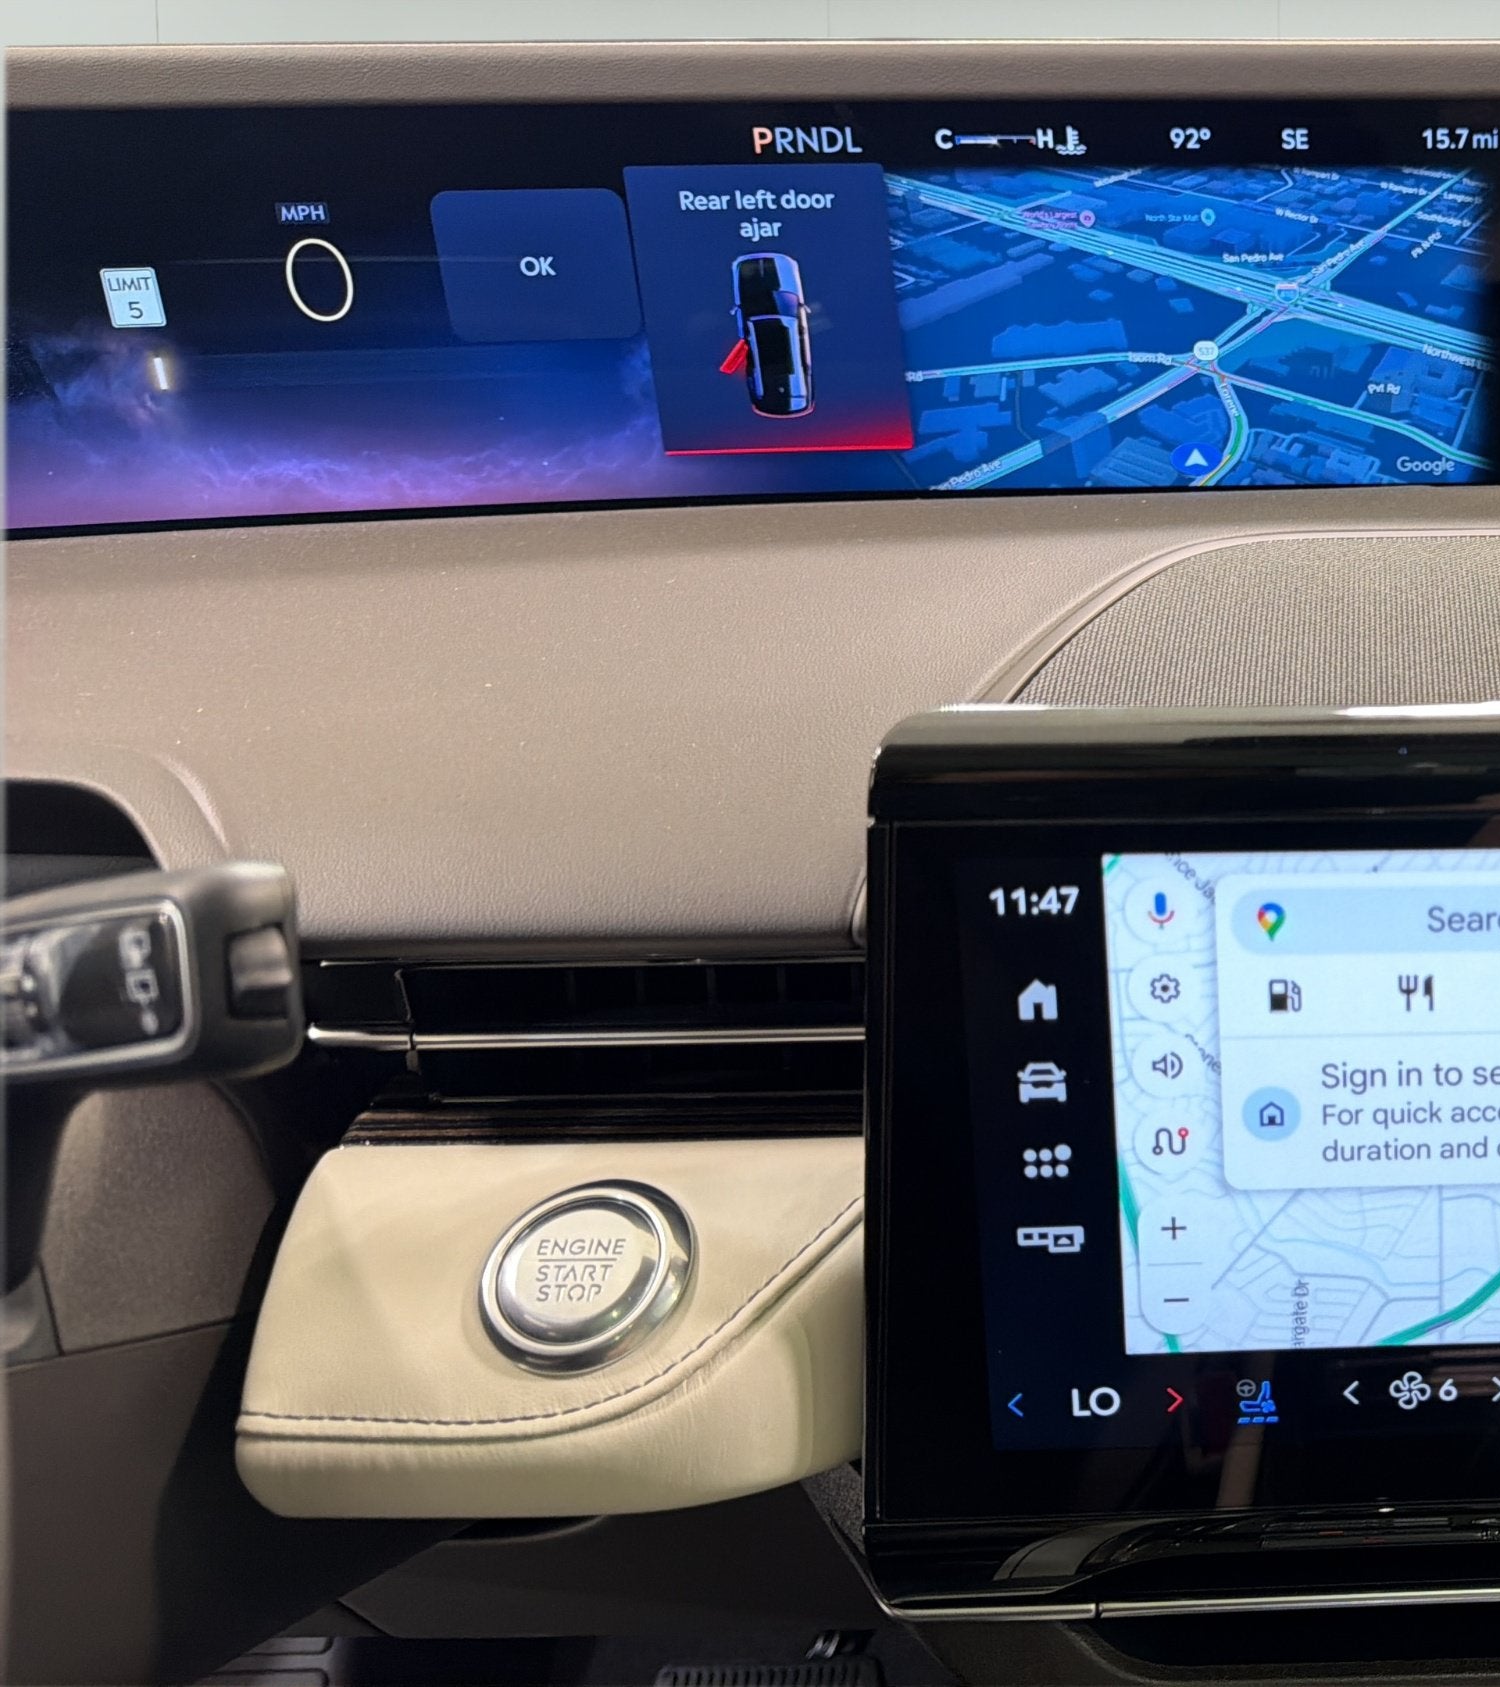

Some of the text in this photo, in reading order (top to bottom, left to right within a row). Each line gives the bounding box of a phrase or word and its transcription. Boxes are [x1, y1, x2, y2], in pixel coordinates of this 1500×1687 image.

[753, 127, 863, 154] PRNDL
[934, 128, 953, 150] C
[1036, 128, 1054, 149] H
[1281, 128, 1309, 150] SE
[1422, 127, 1499, 150] 15.7 mi
[679, 189, 835, 212] Rear left door
[280, 204, 326, 223] MPH
[740, 218, 782, 242] ajar
[519, 256, 557, 277] OK
[1222, 251, 1285, 263] San Pedro Ave
[107, 275, 152, 293] LIMIT
[286, 238, 354, 322] 0
[128, 300, 144, 320] 5
[1396, 456, 1455, 476] Google
[988, 886, 1080, 916] 11:47
[1321, 1062, 1388, 1095] Sign
[1398, 1060, 1423, 1087] in
[1434, 1061, 1463, 1087] to
[1322, 1103, 1363, 1127] For
[1372, 1101, 1442, 1130] quick
[1322, 1138, 1431, 1163] duration
[1440, 1135, 1488, 1160] and
[536, 1238, 627, 1256] ENGINE
[535, 1264, 614, 1282] START
[536, 1284, 602, 1303] STOP
[1438, 1379, 1458, 1401] 6
[1071, 1386, 1121, 1417] LO
